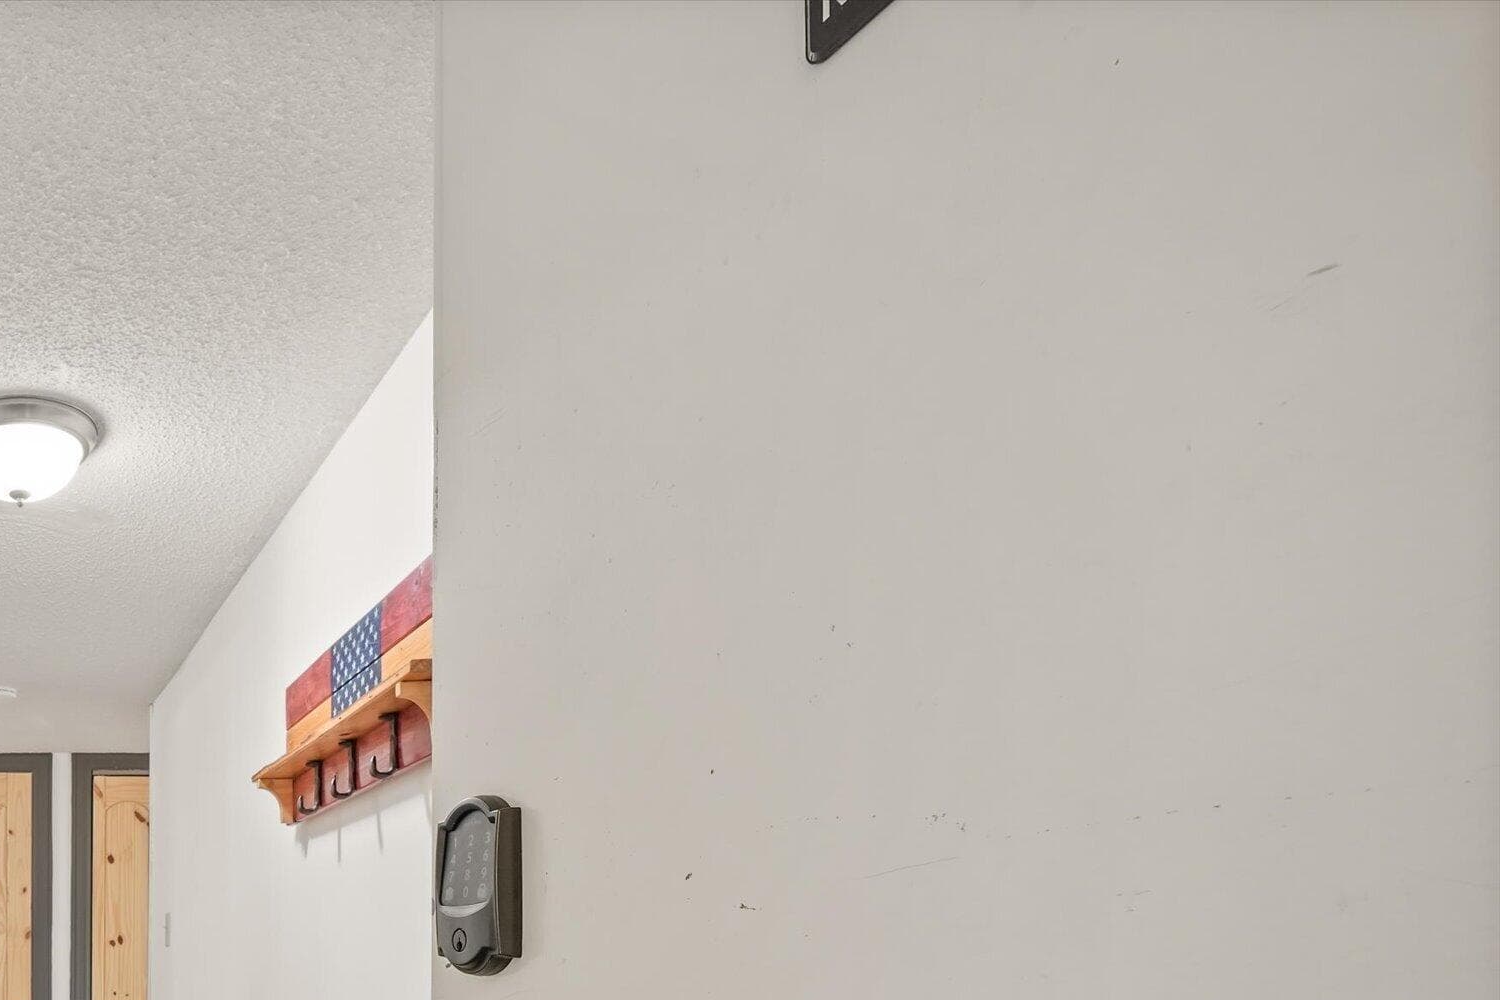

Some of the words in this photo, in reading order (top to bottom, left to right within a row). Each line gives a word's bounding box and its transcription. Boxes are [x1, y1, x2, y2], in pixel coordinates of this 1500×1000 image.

[484, 831, 491, 844] 3
[466, 851, 472, 863] 5
[463, 886, 469, 898] 0
